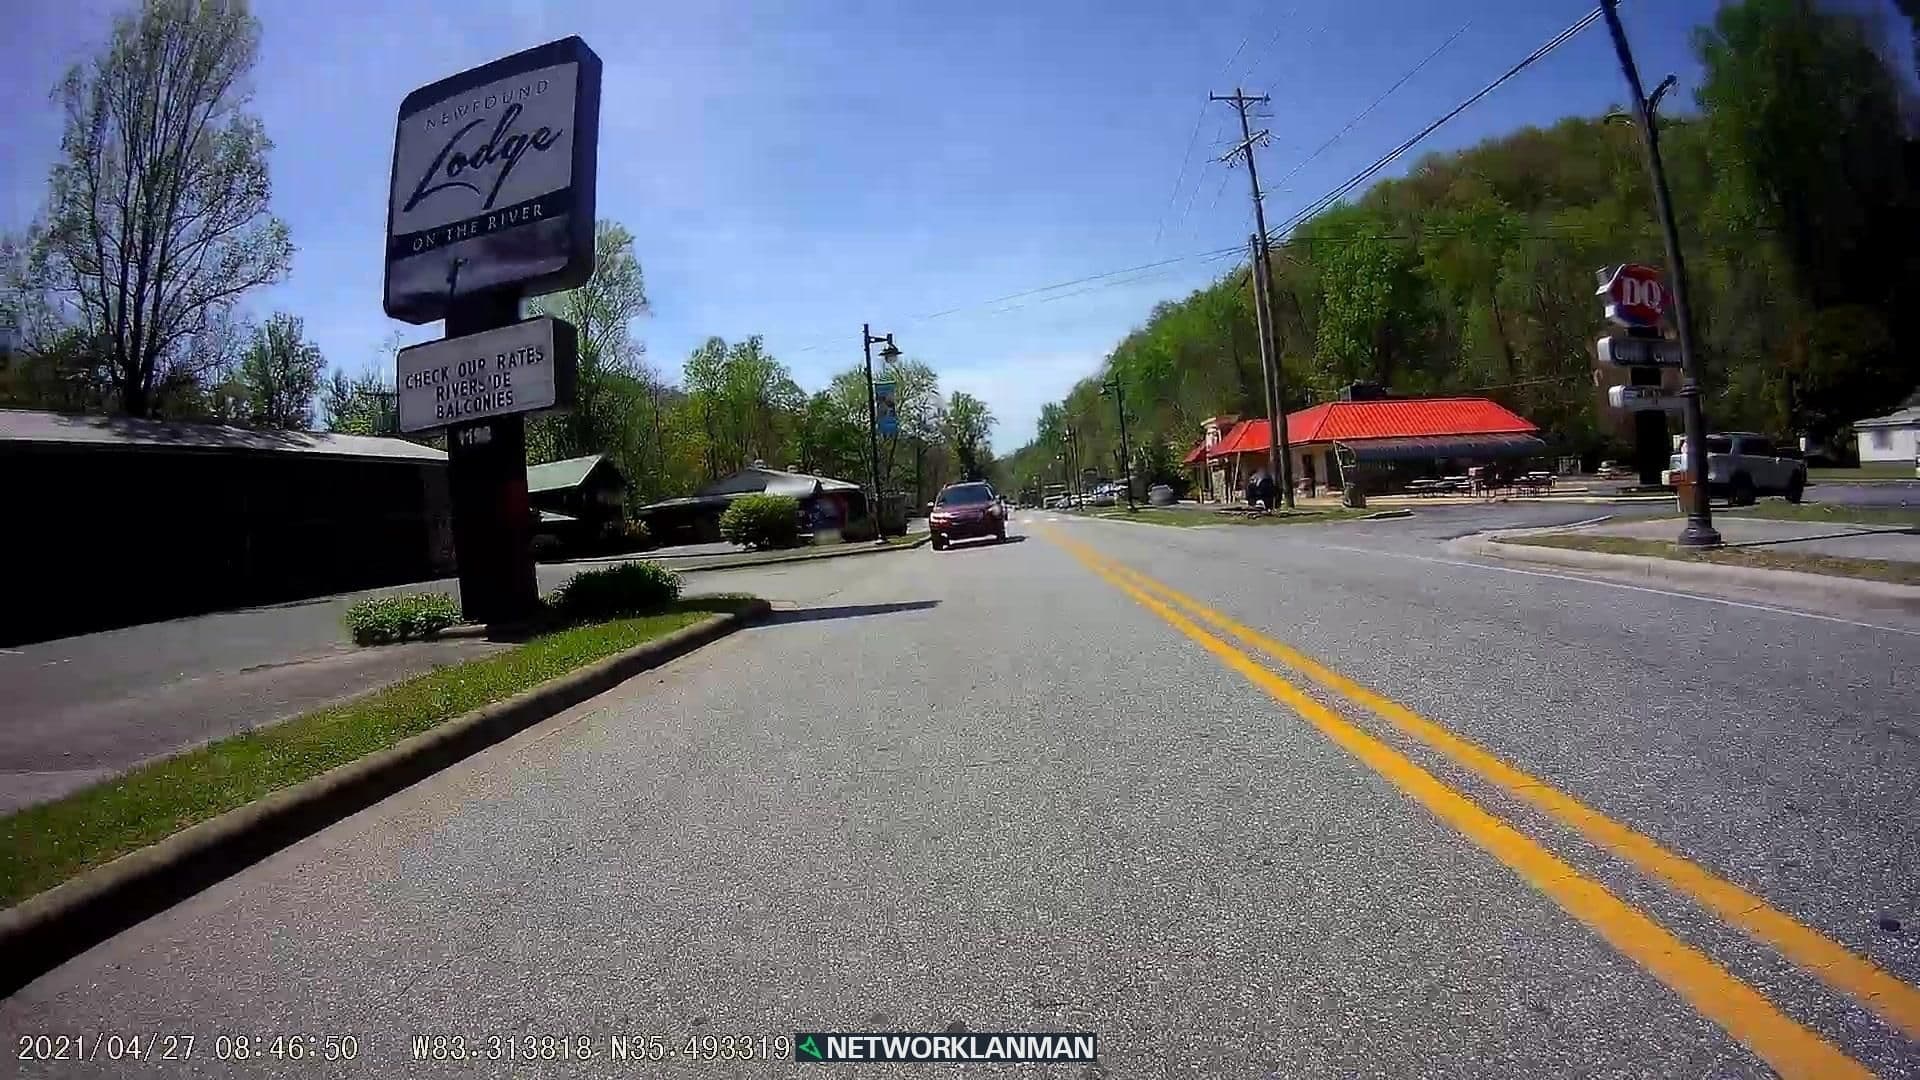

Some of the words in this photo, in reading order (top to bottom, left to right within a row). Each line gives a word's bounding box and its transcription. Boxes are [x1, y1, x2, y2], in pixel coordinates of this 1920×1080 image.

[424, 80, 550, 131] NEWFOUND
[403, 103, 563, 212] Lodge
[413, 234, 436, 252] ON
[447, 221, 478, 240] THE
[488, 203, 544, 229] RIVER
[1623, 276, 1662, 313] DQ
[405, 367, 449, 389] CHECK
[458, 358, 485, 377] OUR
[497, 347, 544, 370] RATES
[436, 391, 513, 418] BALCONIES
